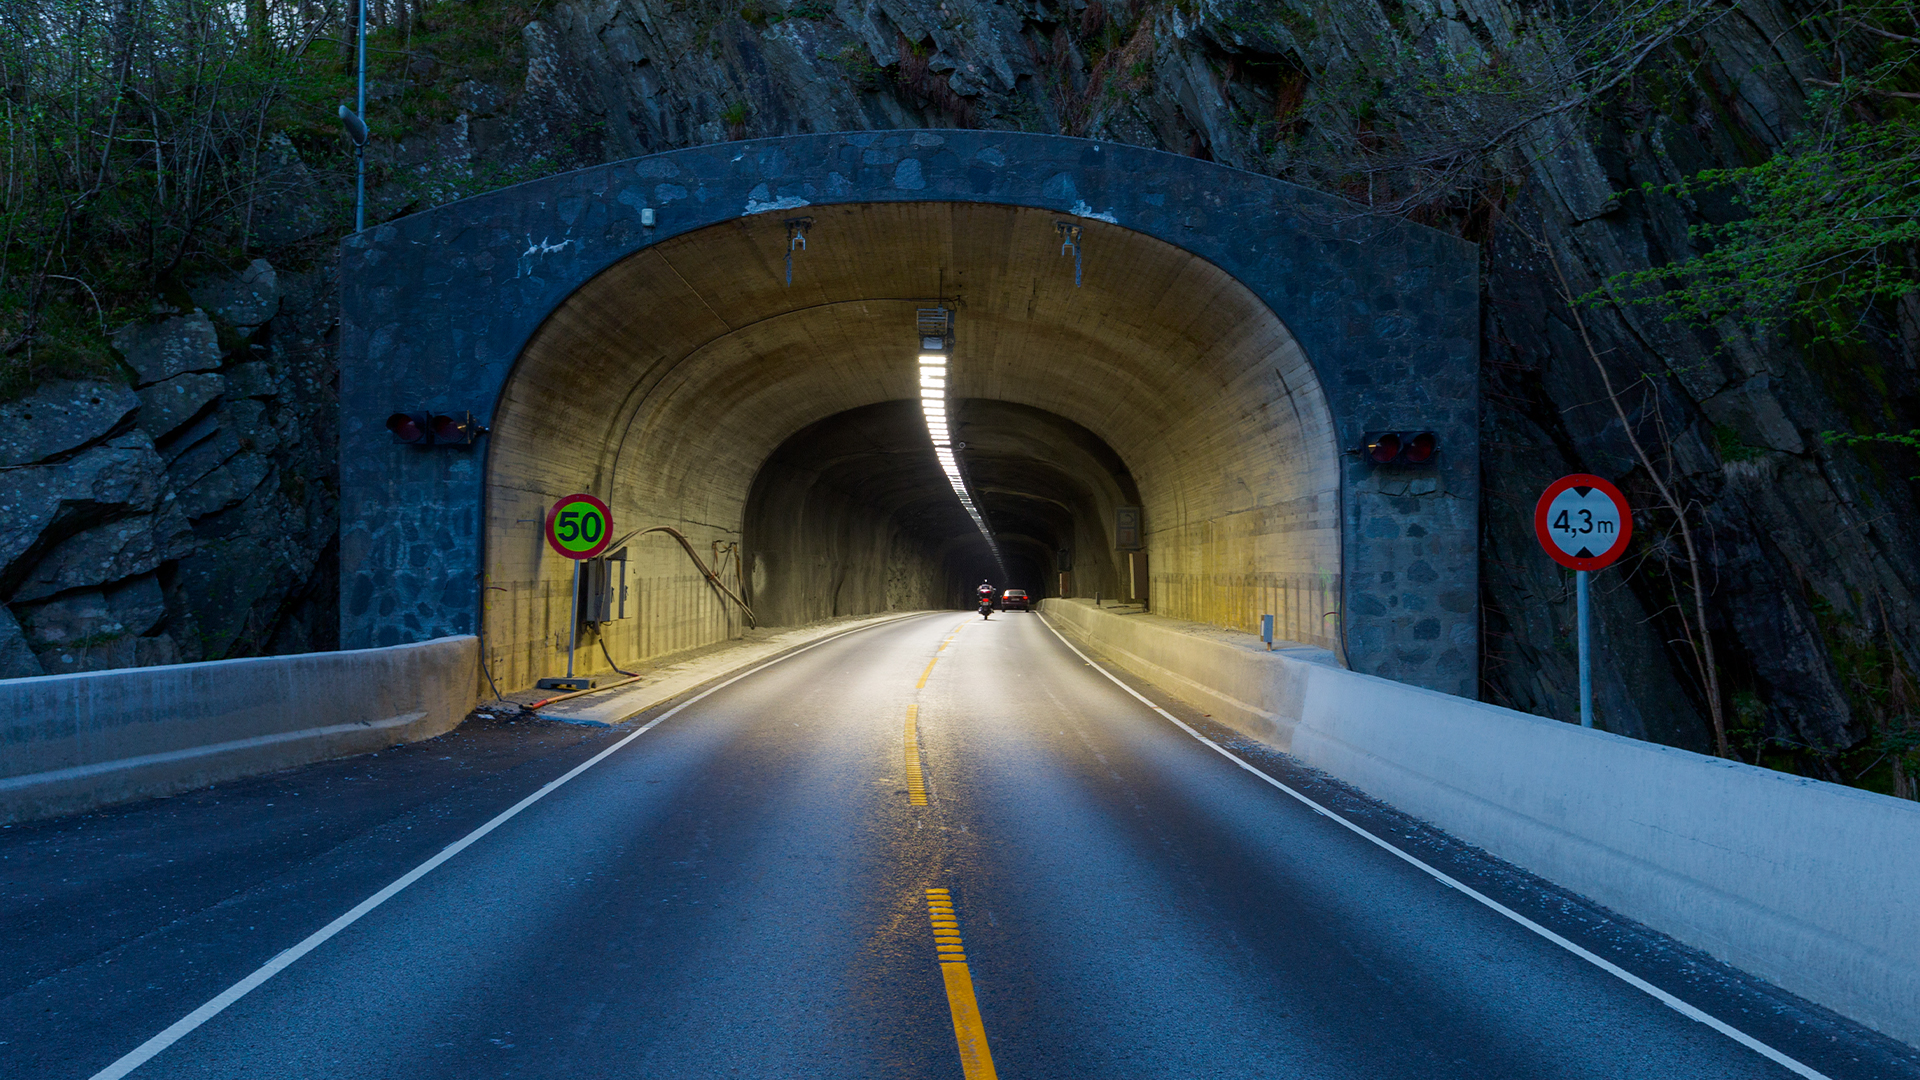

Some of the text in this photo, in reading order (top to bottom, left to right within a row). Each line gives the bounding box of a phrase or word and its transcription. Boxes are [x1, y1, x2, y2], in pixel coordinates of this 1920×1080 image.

[558, 511, 602, 543] 50
[1553, 508, 1614, 539] 4,3 m
